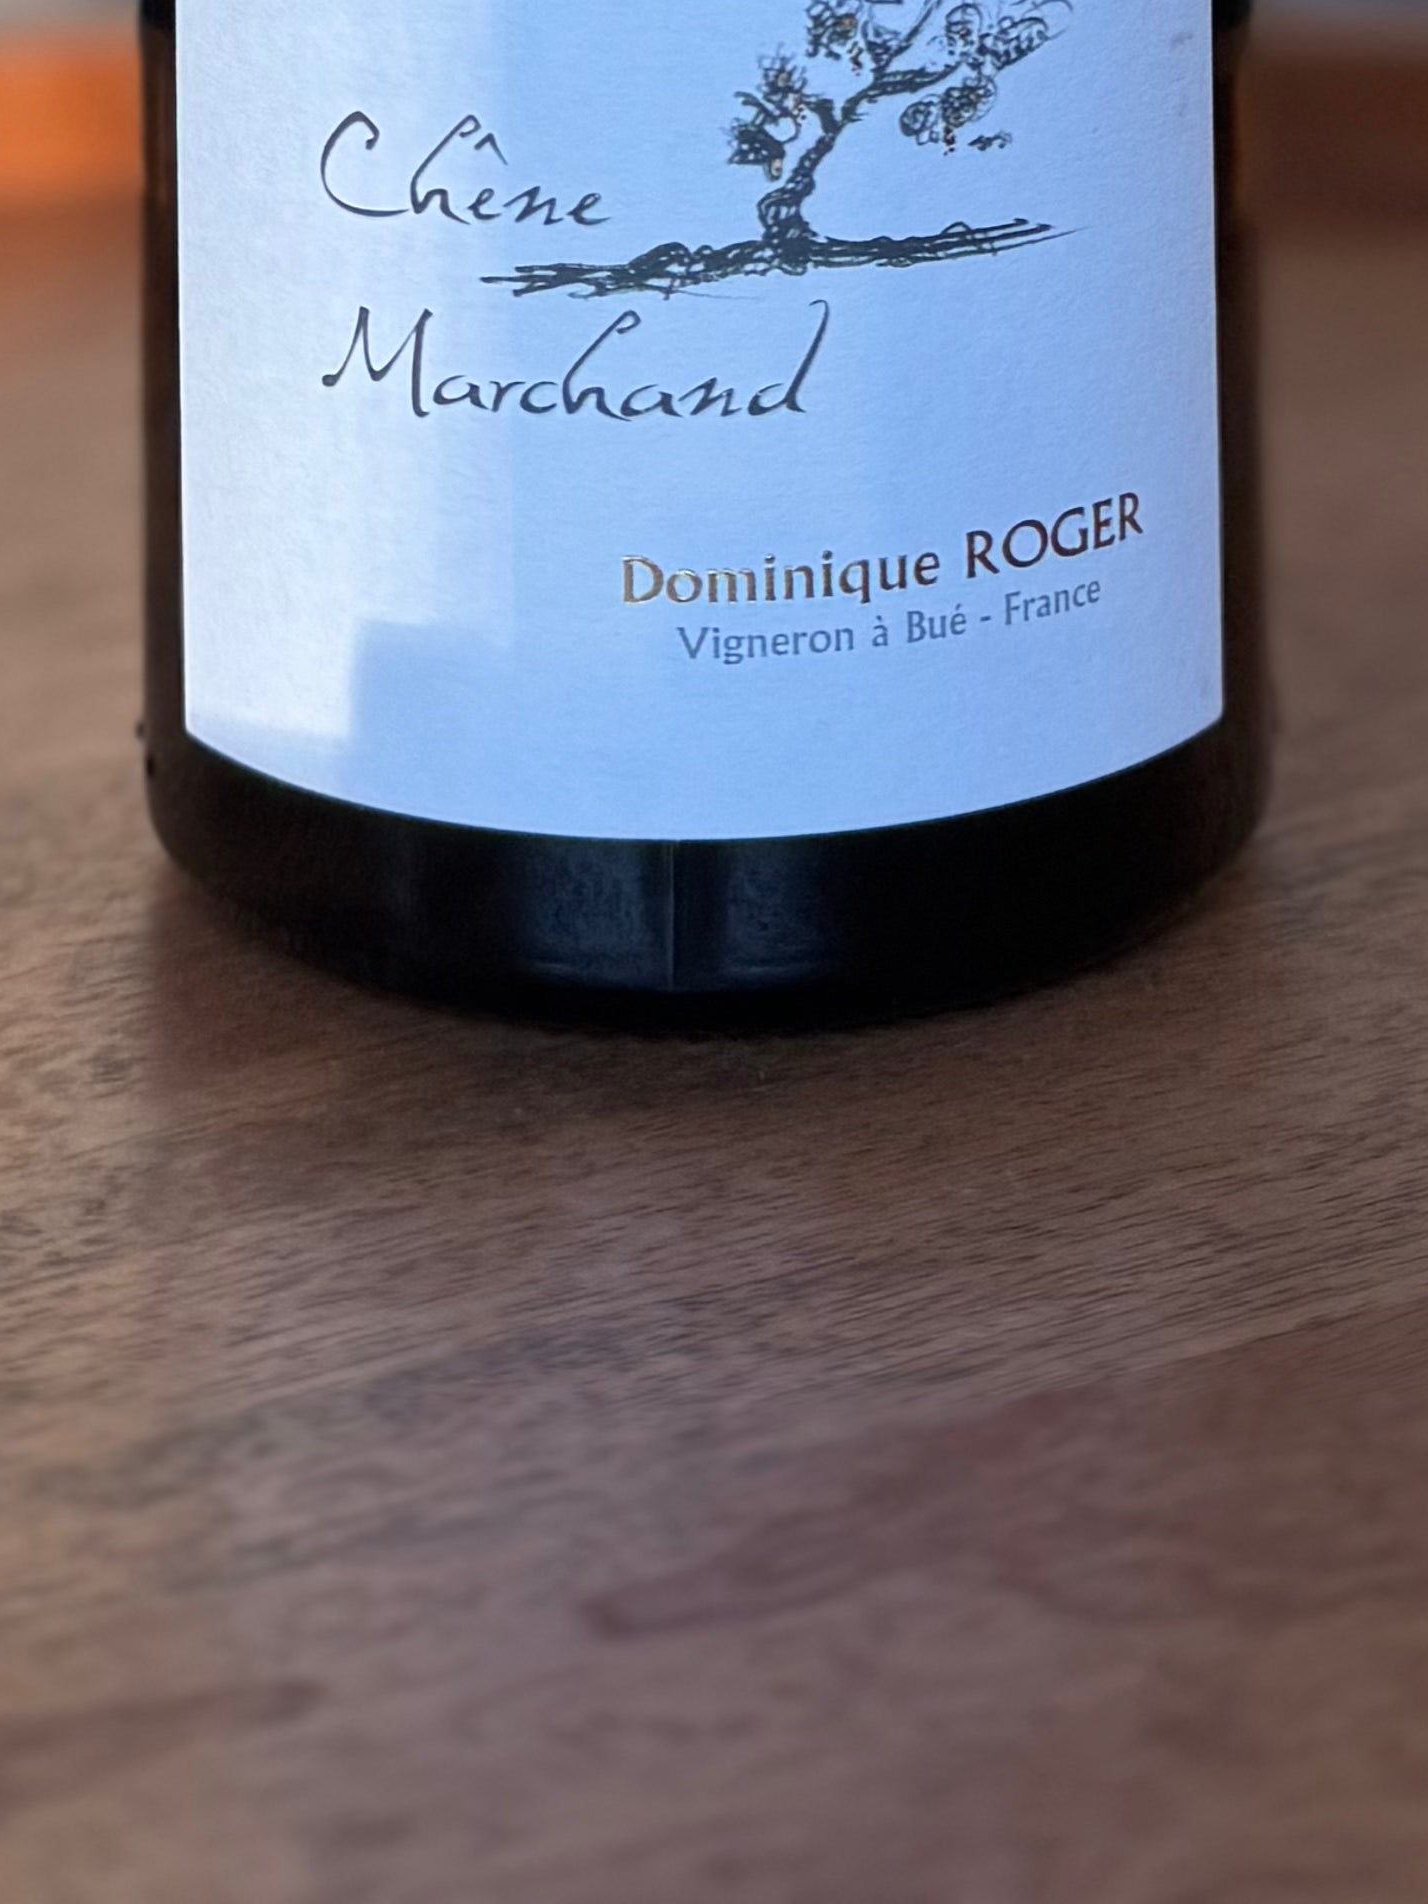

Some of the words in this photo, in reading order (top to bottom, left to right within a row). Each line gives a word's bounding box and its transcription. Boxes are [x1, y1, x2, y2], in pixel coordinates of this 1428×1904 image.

[319, 109, 614, 228] Chêne
[321, 298, 832, 423] Marchand
[621, 548, 941, 604] Dominique
[965, 491, 1145, 582] ROGER
[675, 625, 856, 667] Vigneron
[870, 613, 890, 649] à
[905, 603, 968, 644] Bué
[1003, 579, 1102, 627] France
